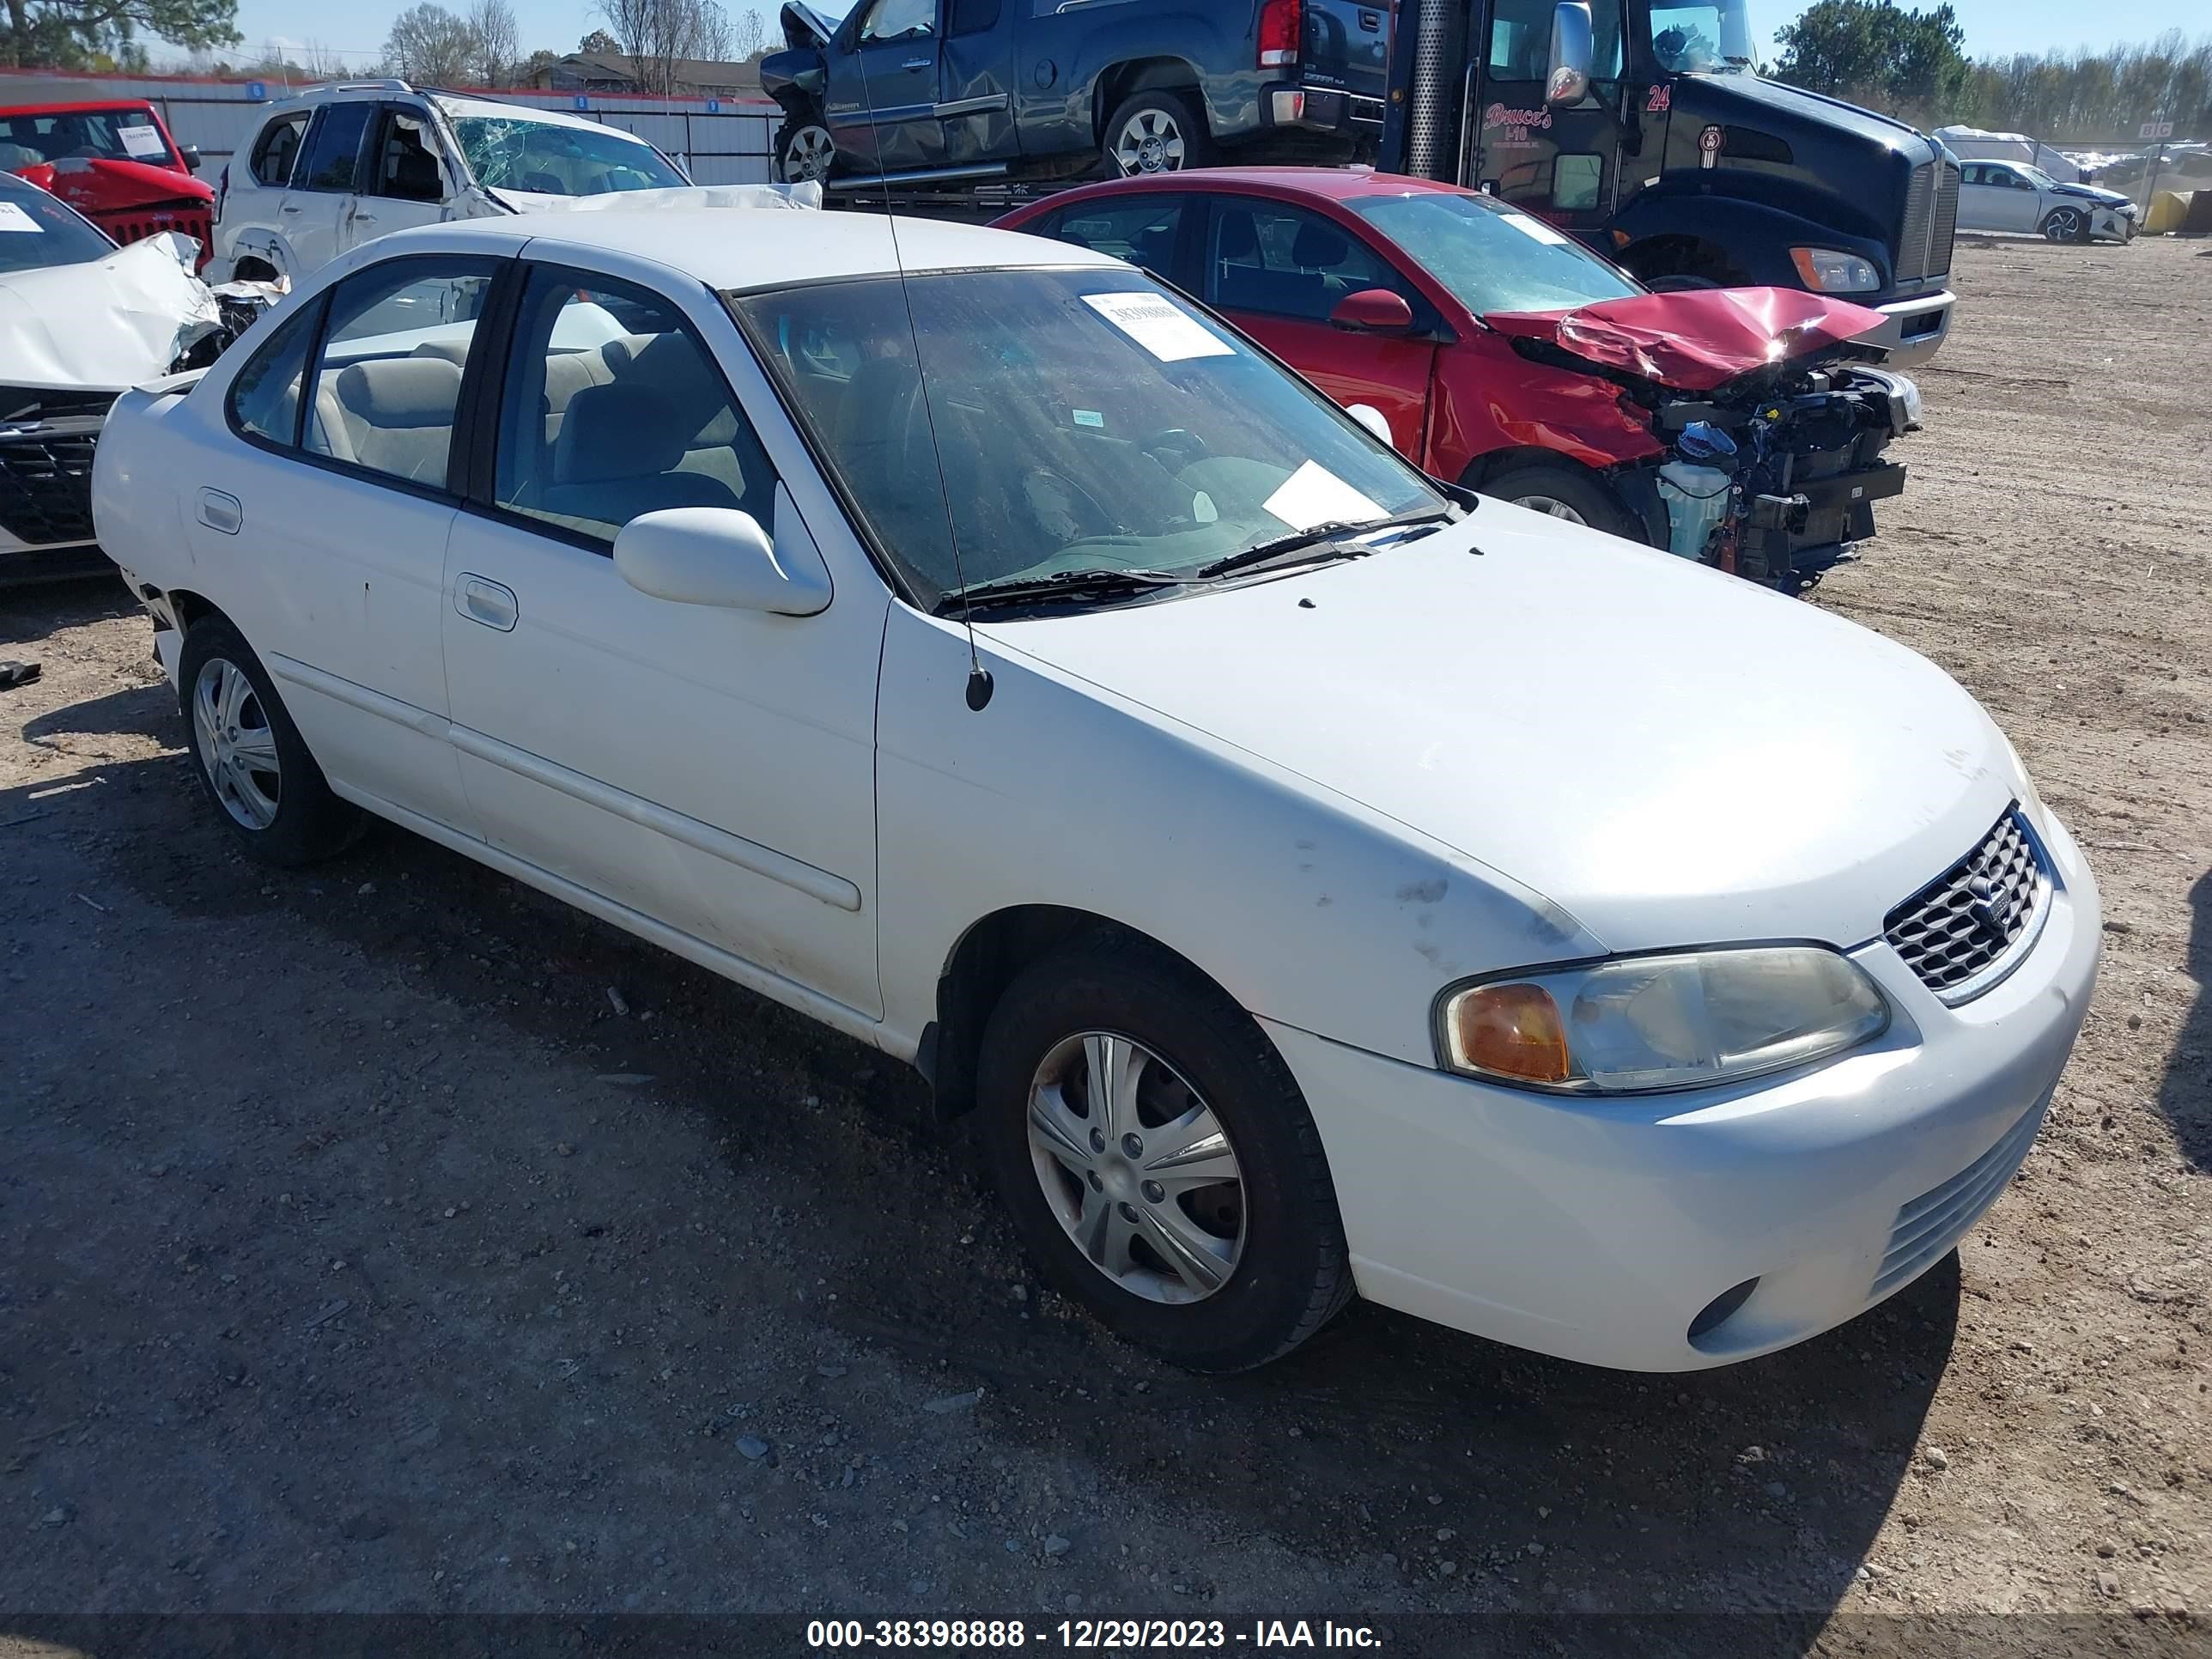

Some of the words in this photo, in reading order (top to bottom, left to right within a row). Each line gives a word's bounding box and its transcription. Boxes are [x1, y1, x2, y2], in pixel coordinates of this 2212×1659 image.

[1646, 84, 1671, 112] 24
[1483, 102, 1553, 131] Bruce's
[1504, 125, 1528, 142] I-10
